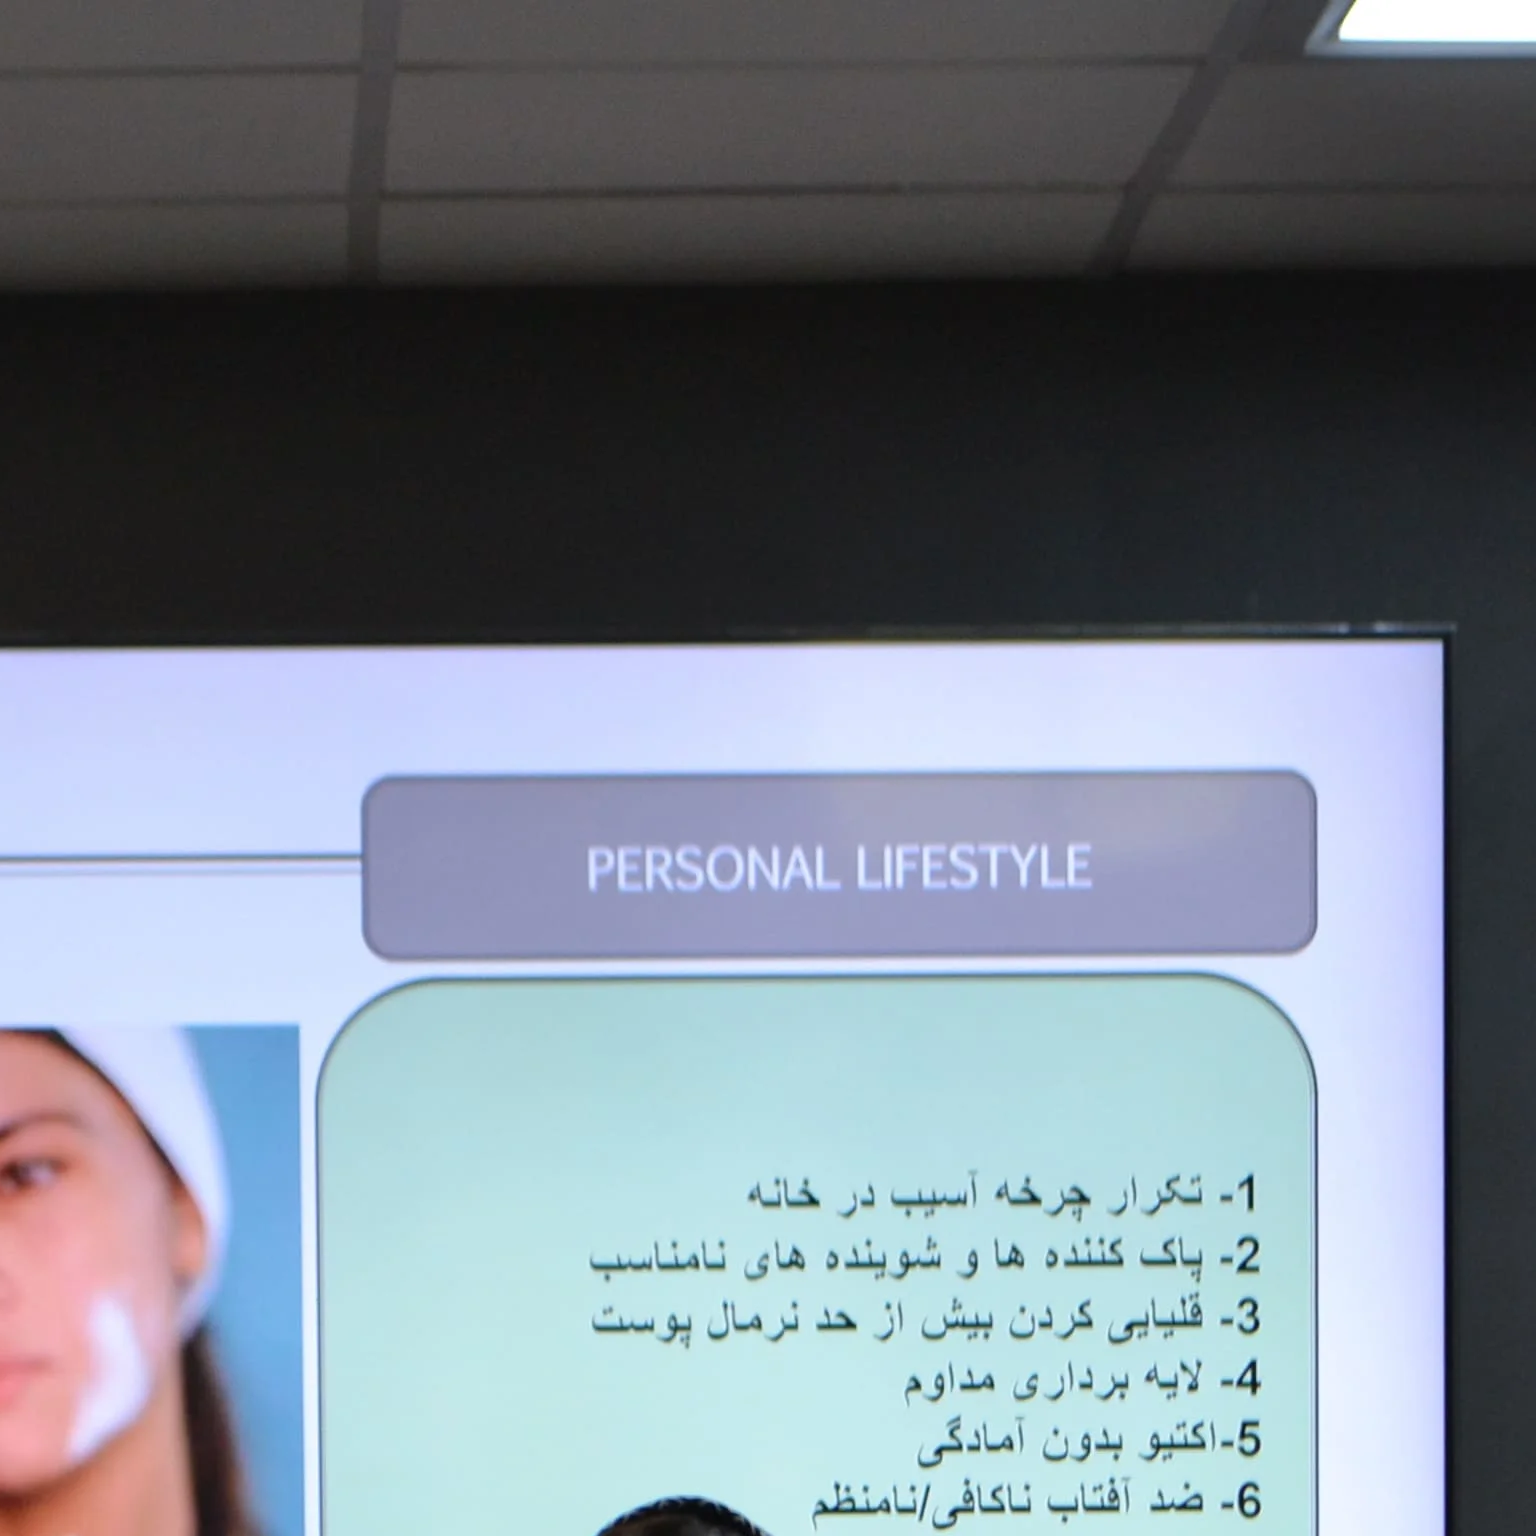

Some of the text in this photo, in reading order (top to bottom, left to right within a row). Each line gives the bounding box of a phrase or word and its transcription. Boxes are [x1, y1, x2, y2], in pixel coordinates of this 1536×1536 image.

[585, 841, 1094, 893] PERSONAL LIFESTYLE
[747, 1176, 822, 1209] خانه
[837, 1182, 877, 1220] در
[890, 1168, 979, 1219] آسیب
[994, 1174, 1093, 1223] چرخه
[1107, 1173, 1204, 1217] تکرار
[589, 1239, 727, 1283] نامناسب
[743, 1239, 807, 1282] های
[825, 1234, 942, 1281] شوینده
[956, 1247, 980, 1280] و
[993, 1237, 1026, 1269] ها
[1045, 1235, 1125, 1269] کننده
[1139, 1235, 1205, 1284] پاک
[591, 1305, 693, 1350] پوست
[706, 1299, 800, 1343] نرمال
[815, 1306, 859, 1332] حد
[873, 1299, 904, 1343] از
[920, 1296, 995, 1342] بیش
[1008, 1298, 1095, 1341] کردن
[1107, 1290, 1205, 1346] قلیایی
[904, 1361, 996, 1407] مداوم
[1012, 1360, 1131, 1402] برداری
[1143, 1358, 1204, 1401] لایه
[916, 1413, 1026, 1470] آمادگی
[1041, 1426, 1124, 1463] بدون
[1046, 1475, 1132, 1525] آفتاب
[1149, 1480, 1205, 1513] ضد
